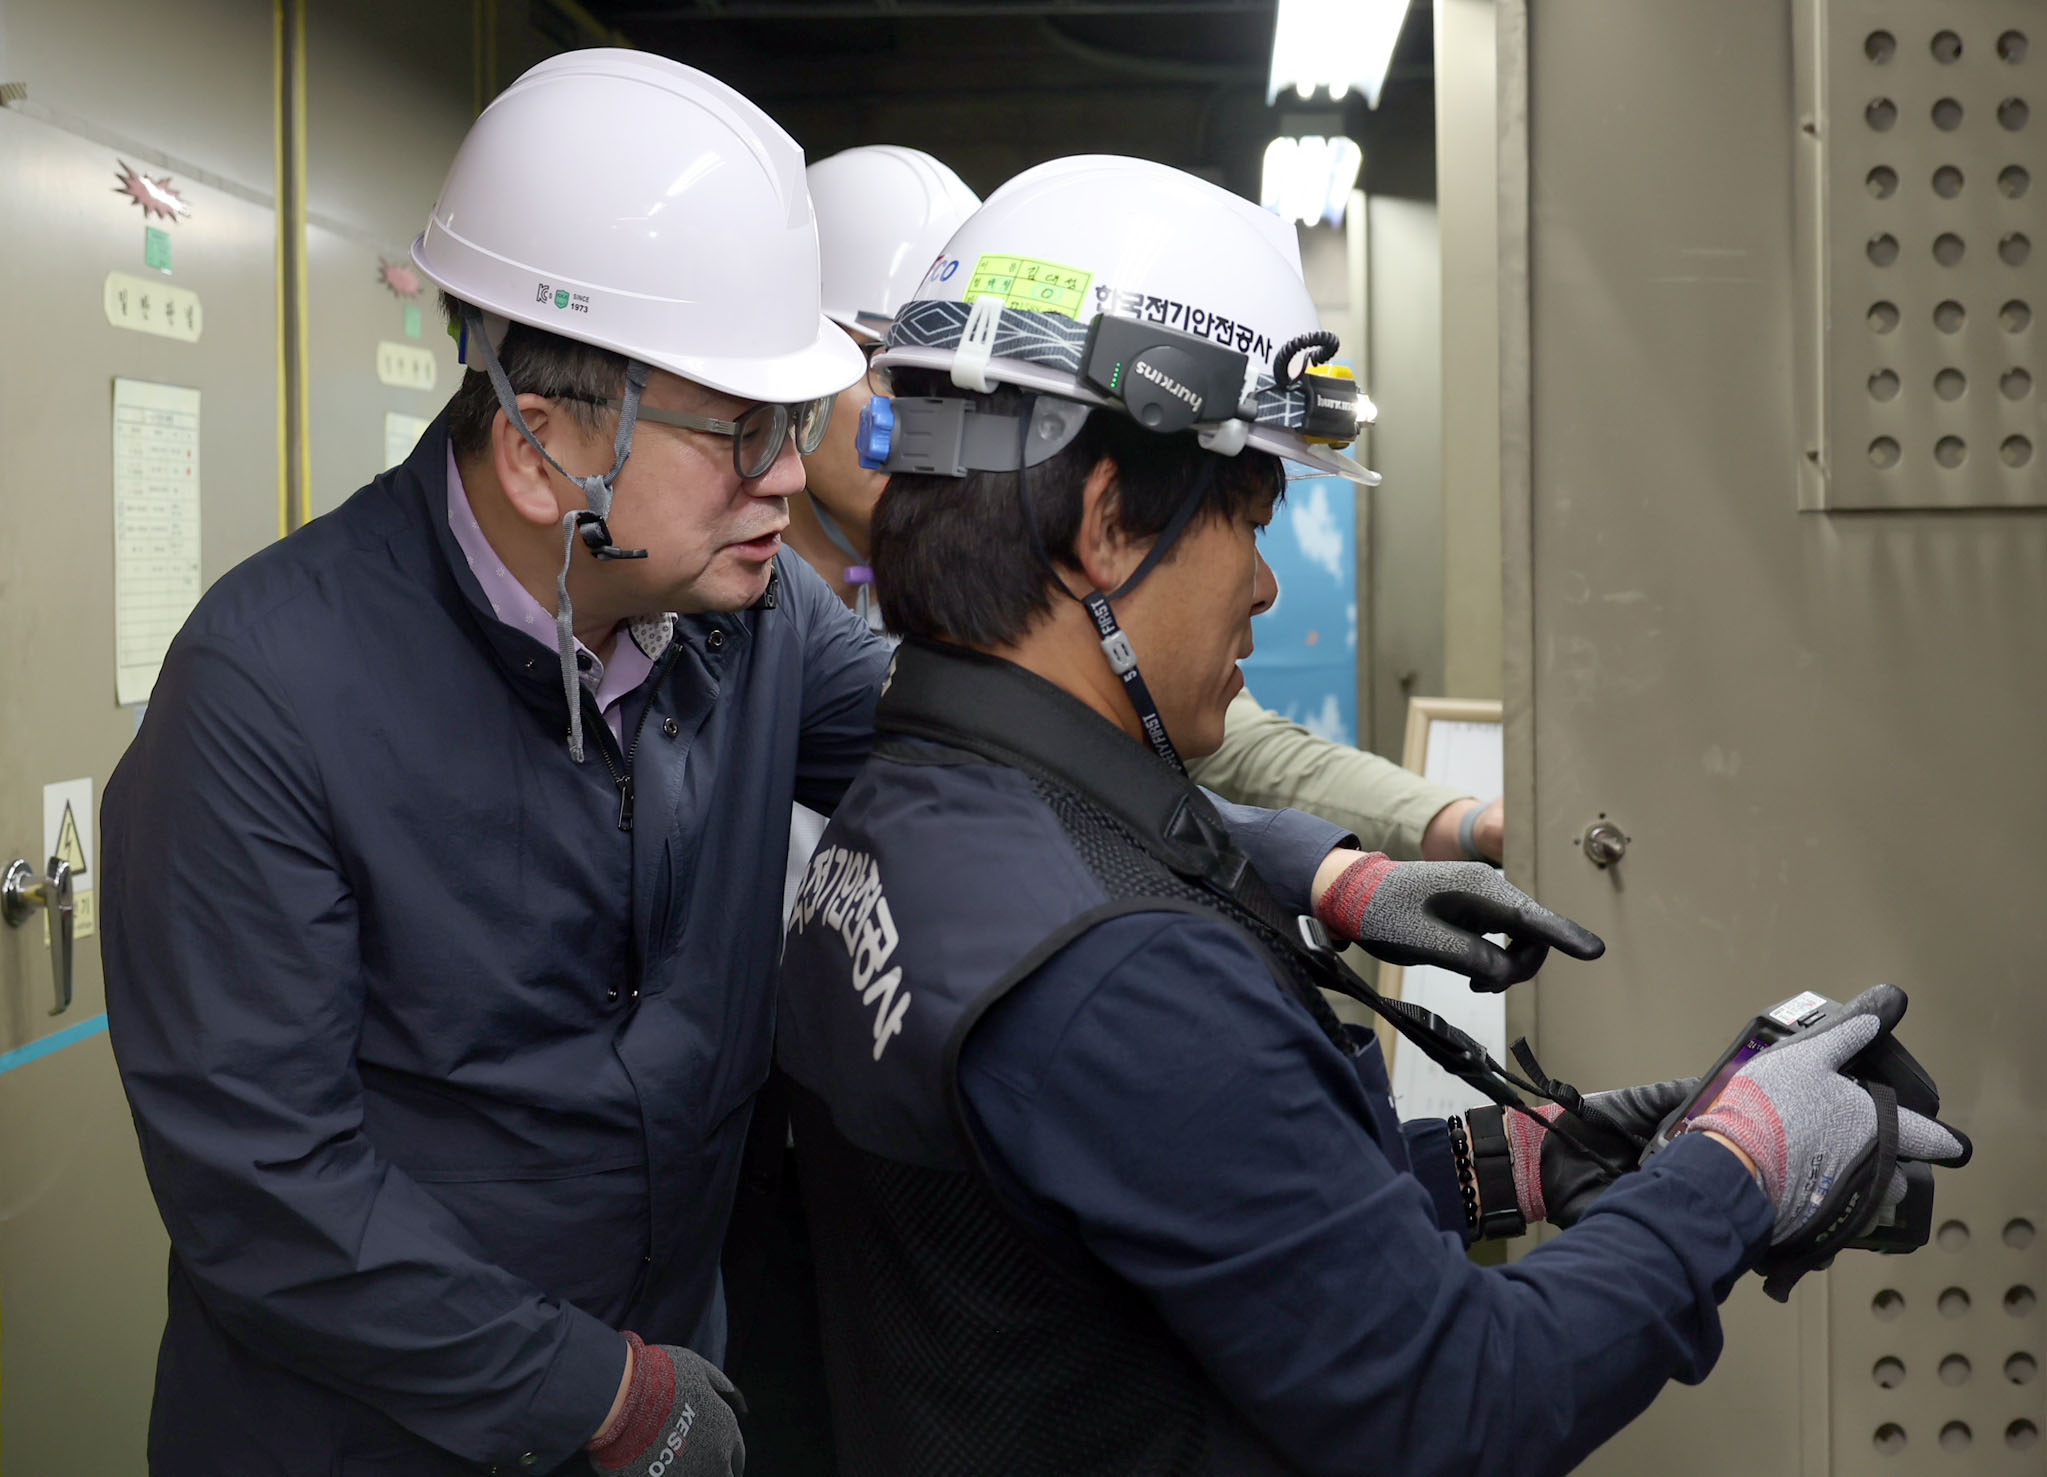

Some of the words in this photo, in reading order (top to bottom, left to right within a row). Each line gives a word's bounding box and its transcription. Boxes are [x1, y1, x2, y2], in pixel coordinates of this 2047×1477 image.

[571, 302, 588, 313] 1973
[1135, 360, 1203, 412] hurkins
[1091, 599, 1116, 637] FIRST
[1142, 712, 1167, 744] FIRST
[648, 1402, 697, 1477] KESCO
